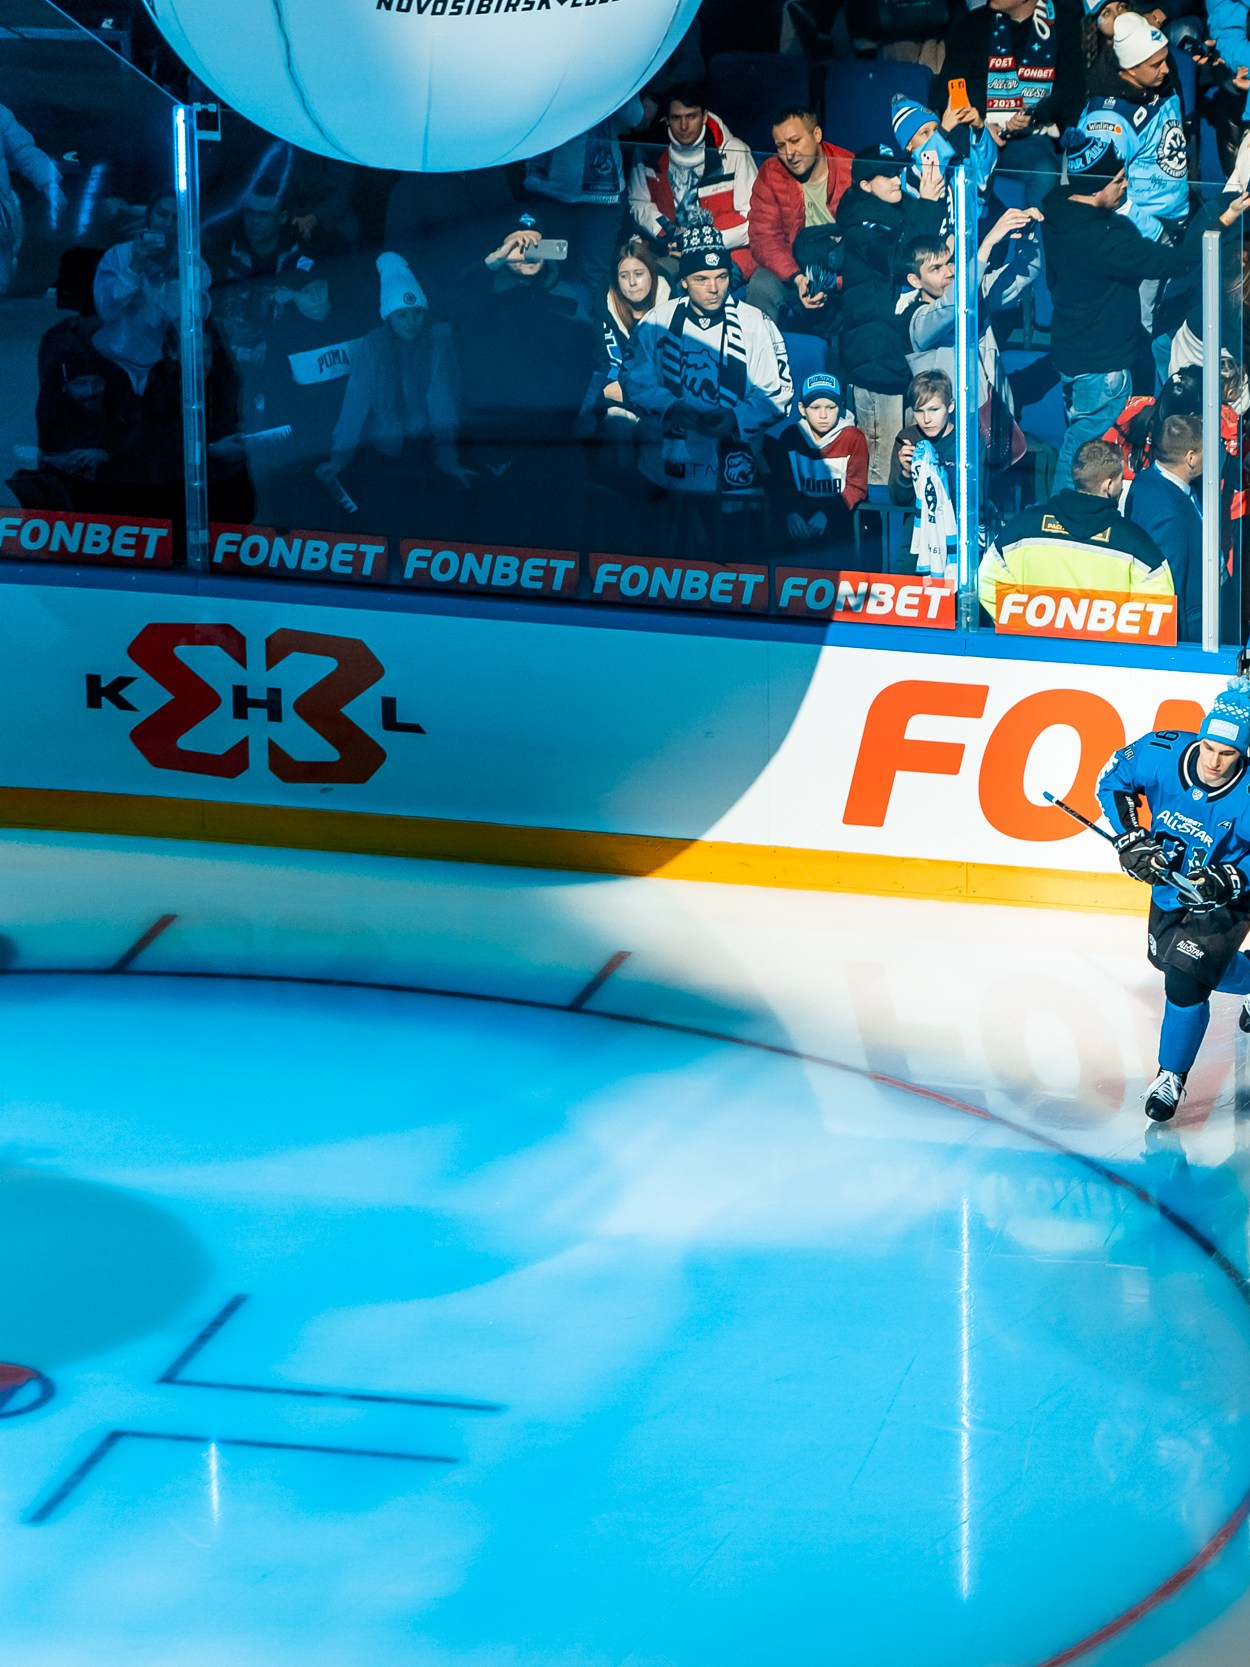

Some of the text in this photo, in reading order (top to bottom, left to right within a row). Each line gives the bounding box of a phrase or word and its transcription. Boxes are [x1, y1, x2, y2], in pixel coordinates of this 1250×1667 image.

[1018, 67, 1054, 78] FONBET
[1088, 122, 1114, 131] Winline
[317, 349, 350, 374] PUMA
[0, 517, 168, 559] FONBET
[212, 532, 385, 576] FONBET
[402, 548, 576, 591] FONBET
[593, 563, 765, 605] FONBET
[778, 576, 952, 620] FONBET
[998, 593, 1173, 636] FONBET
[1173, 811, 1205, 828] FONBET
[1223, 864, 1241, 900] CCM
